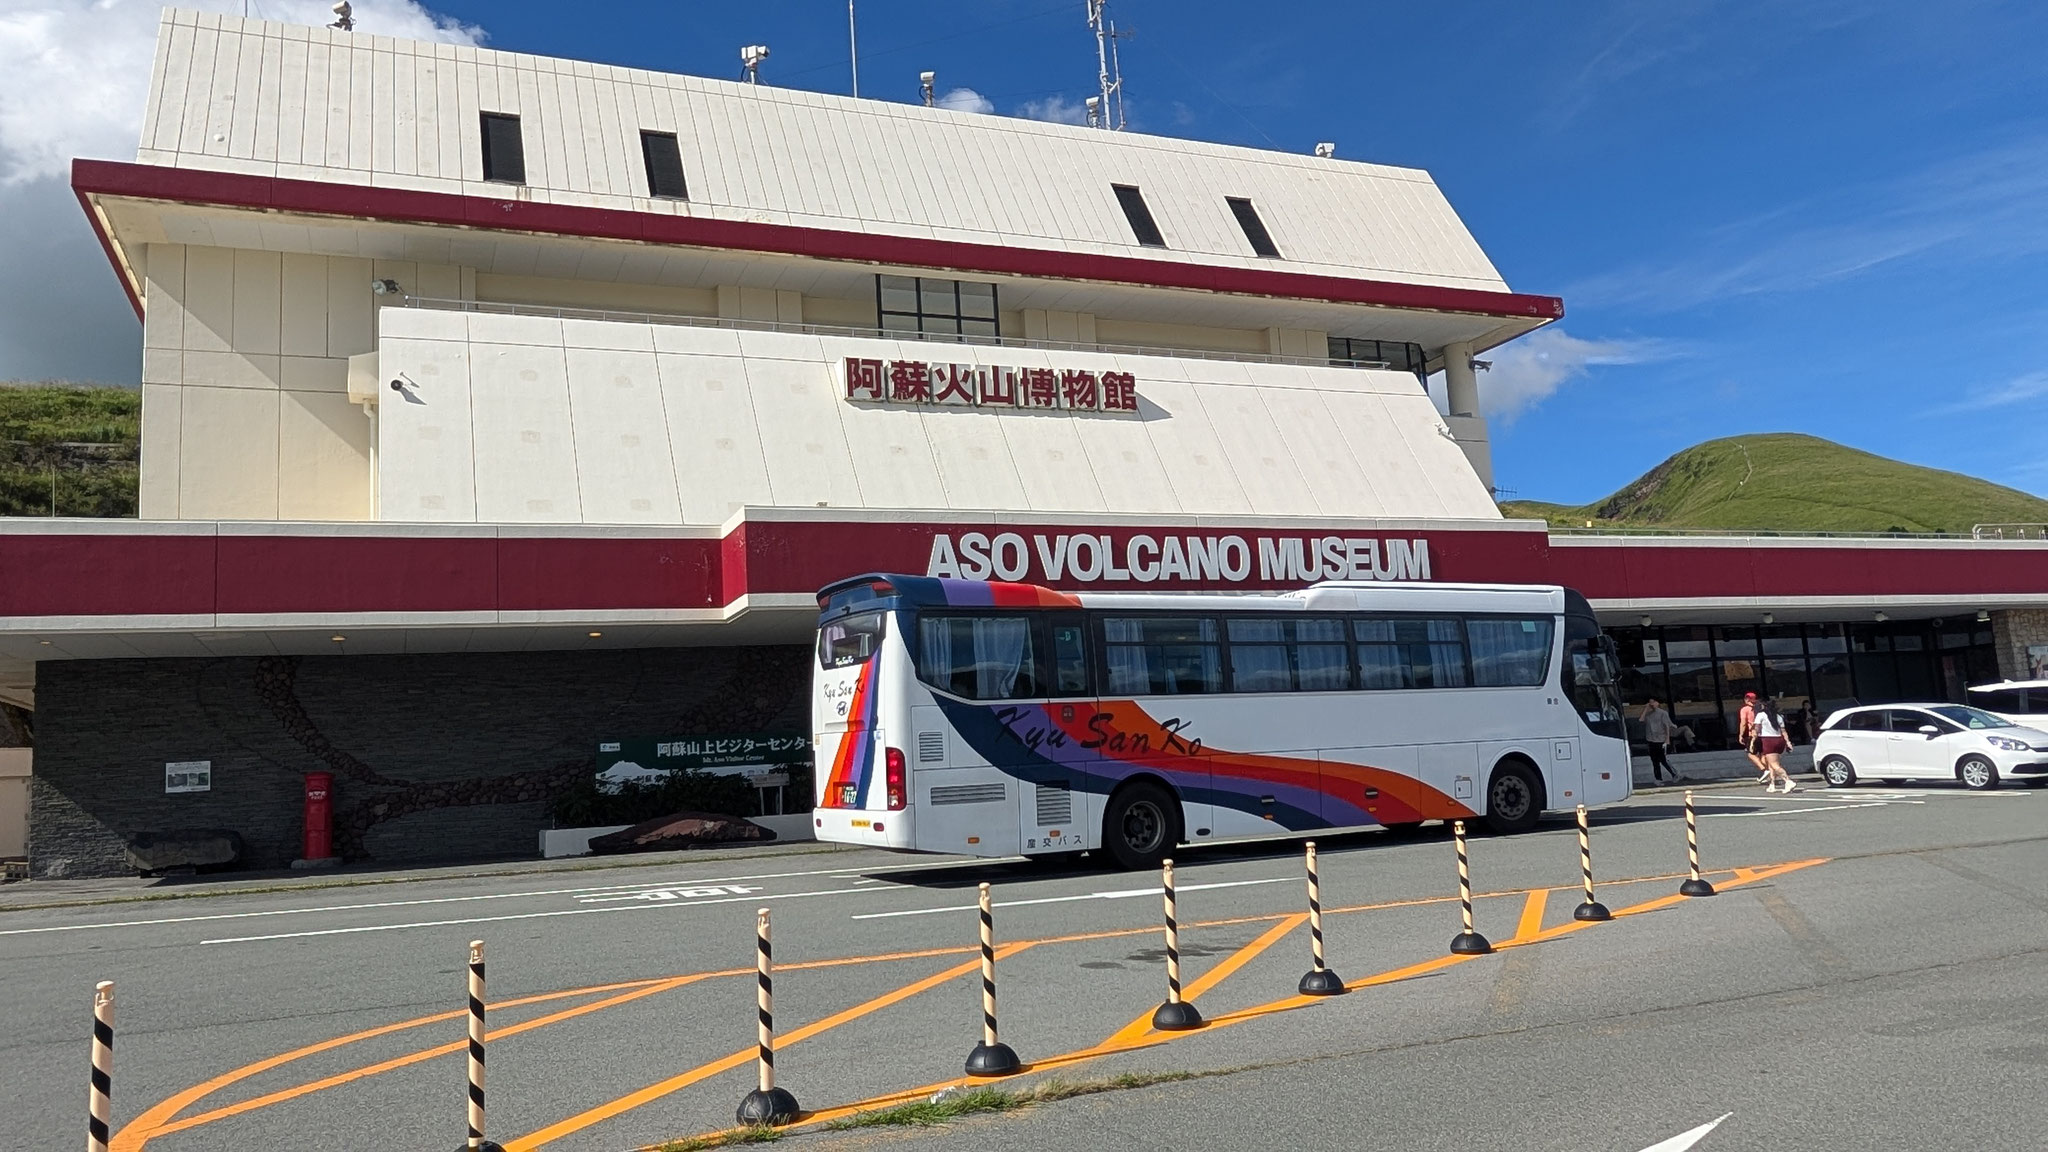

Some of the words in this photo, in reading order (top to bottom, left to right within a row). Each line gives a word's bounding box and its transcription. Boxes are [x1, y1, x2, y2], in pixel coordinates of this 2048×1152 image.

[844, 356, 1138, 412] 阿蘇火山博物館
[926, 532, 1030, 582] ASO
[1034, 532, 1251, 583] VOLCANO
[1257, 535, 1432, 582] MUSEUM
[994, 706, 1067, 758] Kyu
[1080, 713, 1151, 753] San
[1160, 717, 1202, 756] Ko
